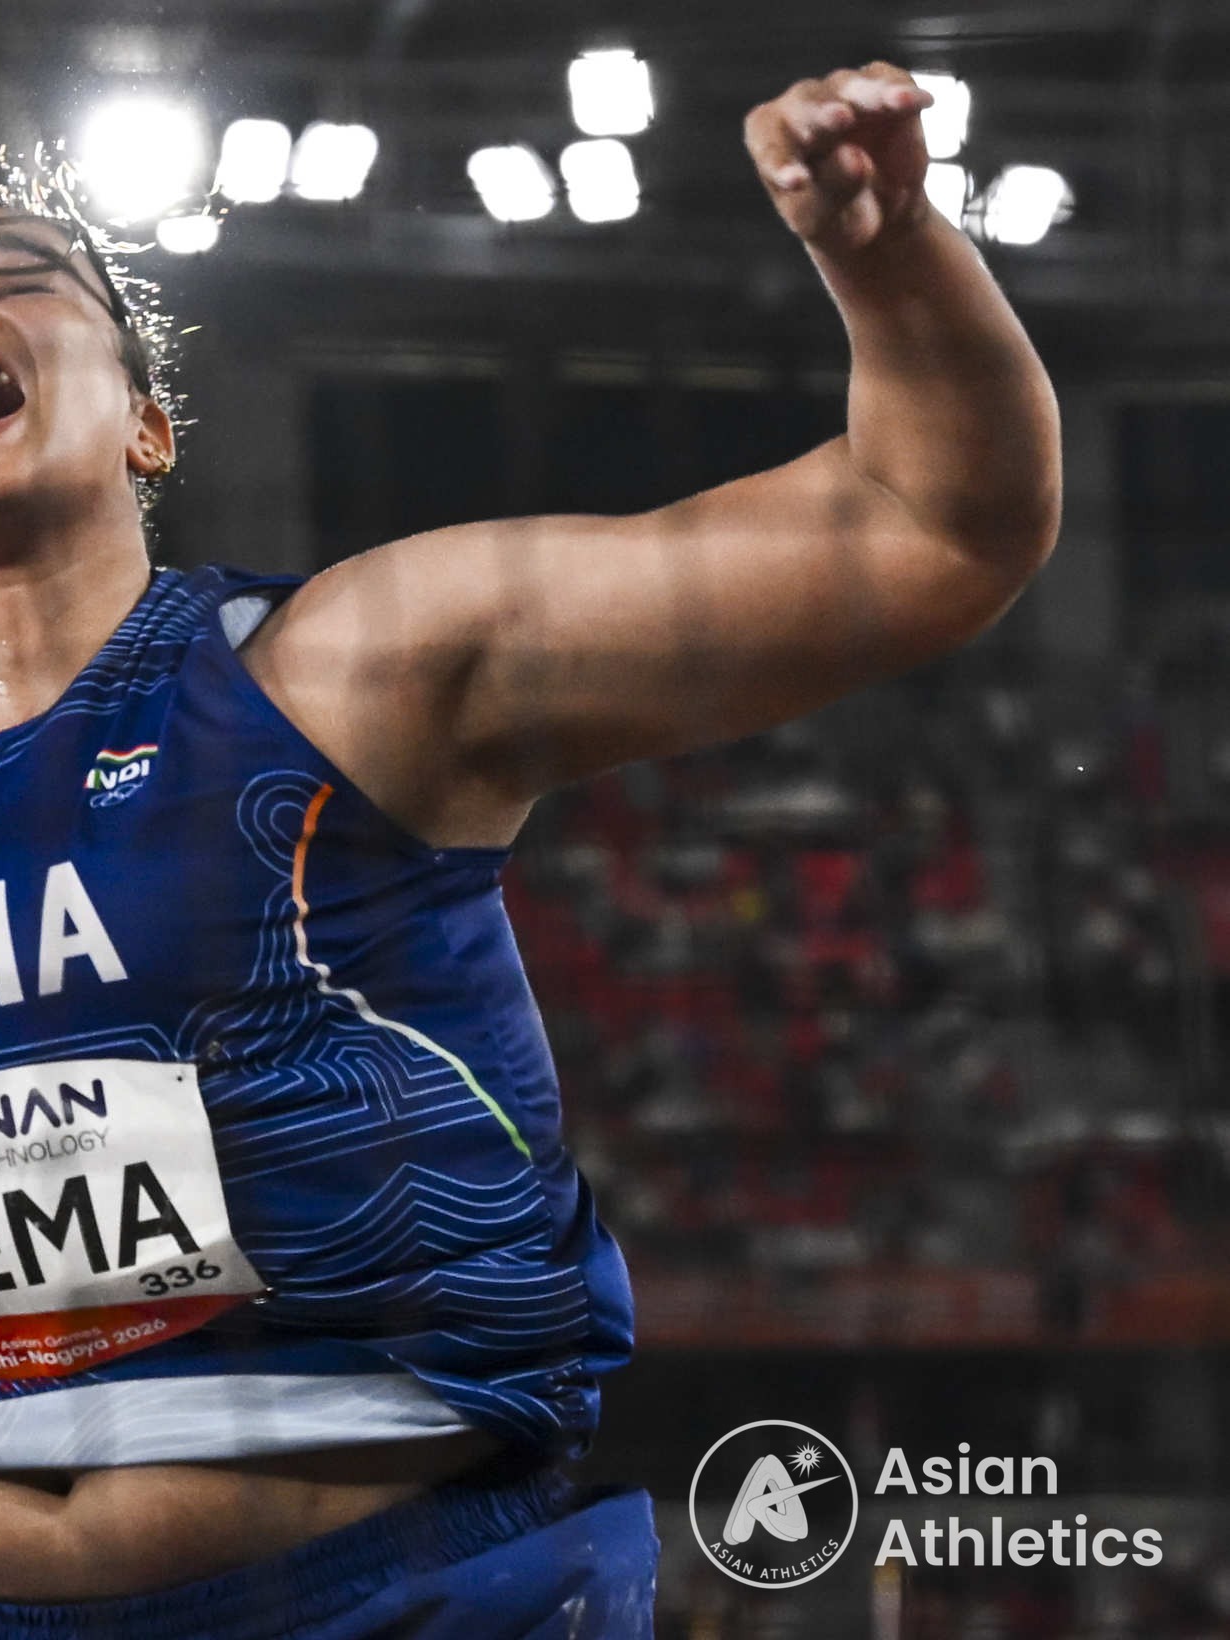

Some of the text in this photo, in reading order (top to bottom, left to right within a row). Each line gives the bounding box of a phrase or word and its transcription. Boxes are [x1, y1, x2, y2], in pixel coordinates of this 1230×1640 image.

[138, 1258, 222, 1297] 336
[0, 1336, 43, 1351] Asian
[43, 1326, 104, 1348] Games
[112, 1318, 168, 1345] 2026
